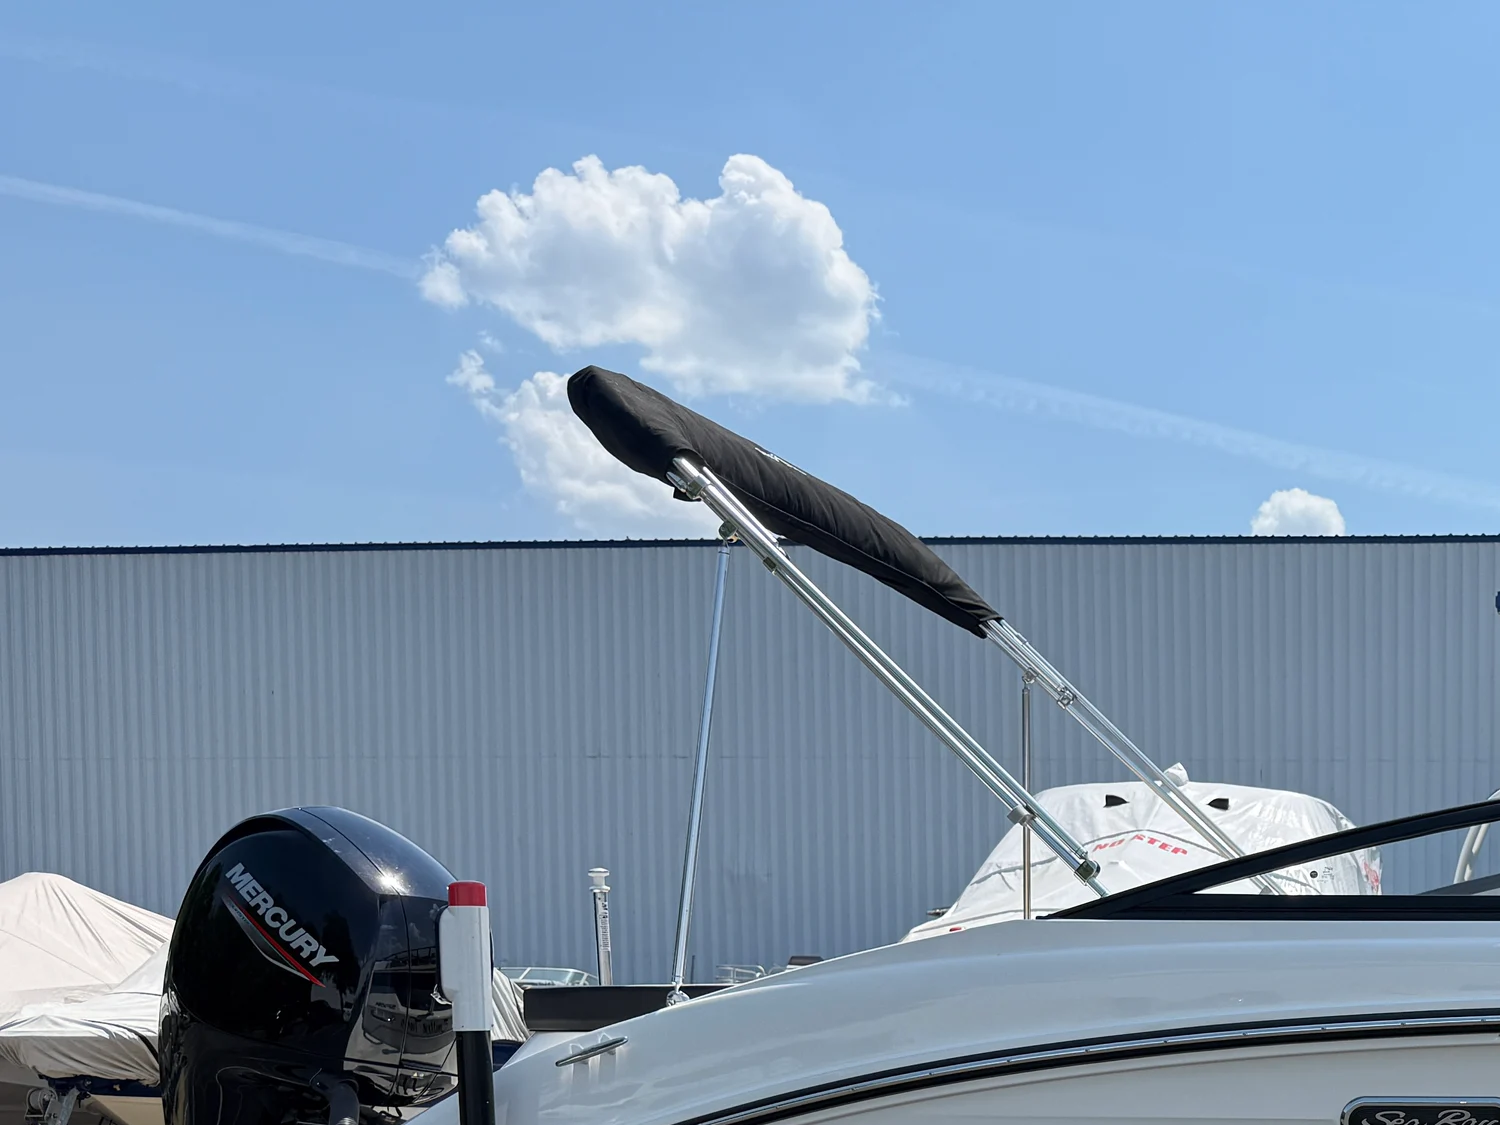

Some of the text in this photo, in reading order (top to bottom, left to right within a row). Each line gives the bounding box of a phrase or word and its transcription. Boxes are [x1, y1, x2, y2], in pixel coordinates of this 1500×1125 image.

[1092, 833, 1188, 855] NO STEP
[225, 862, 340, 967] MERCURY
